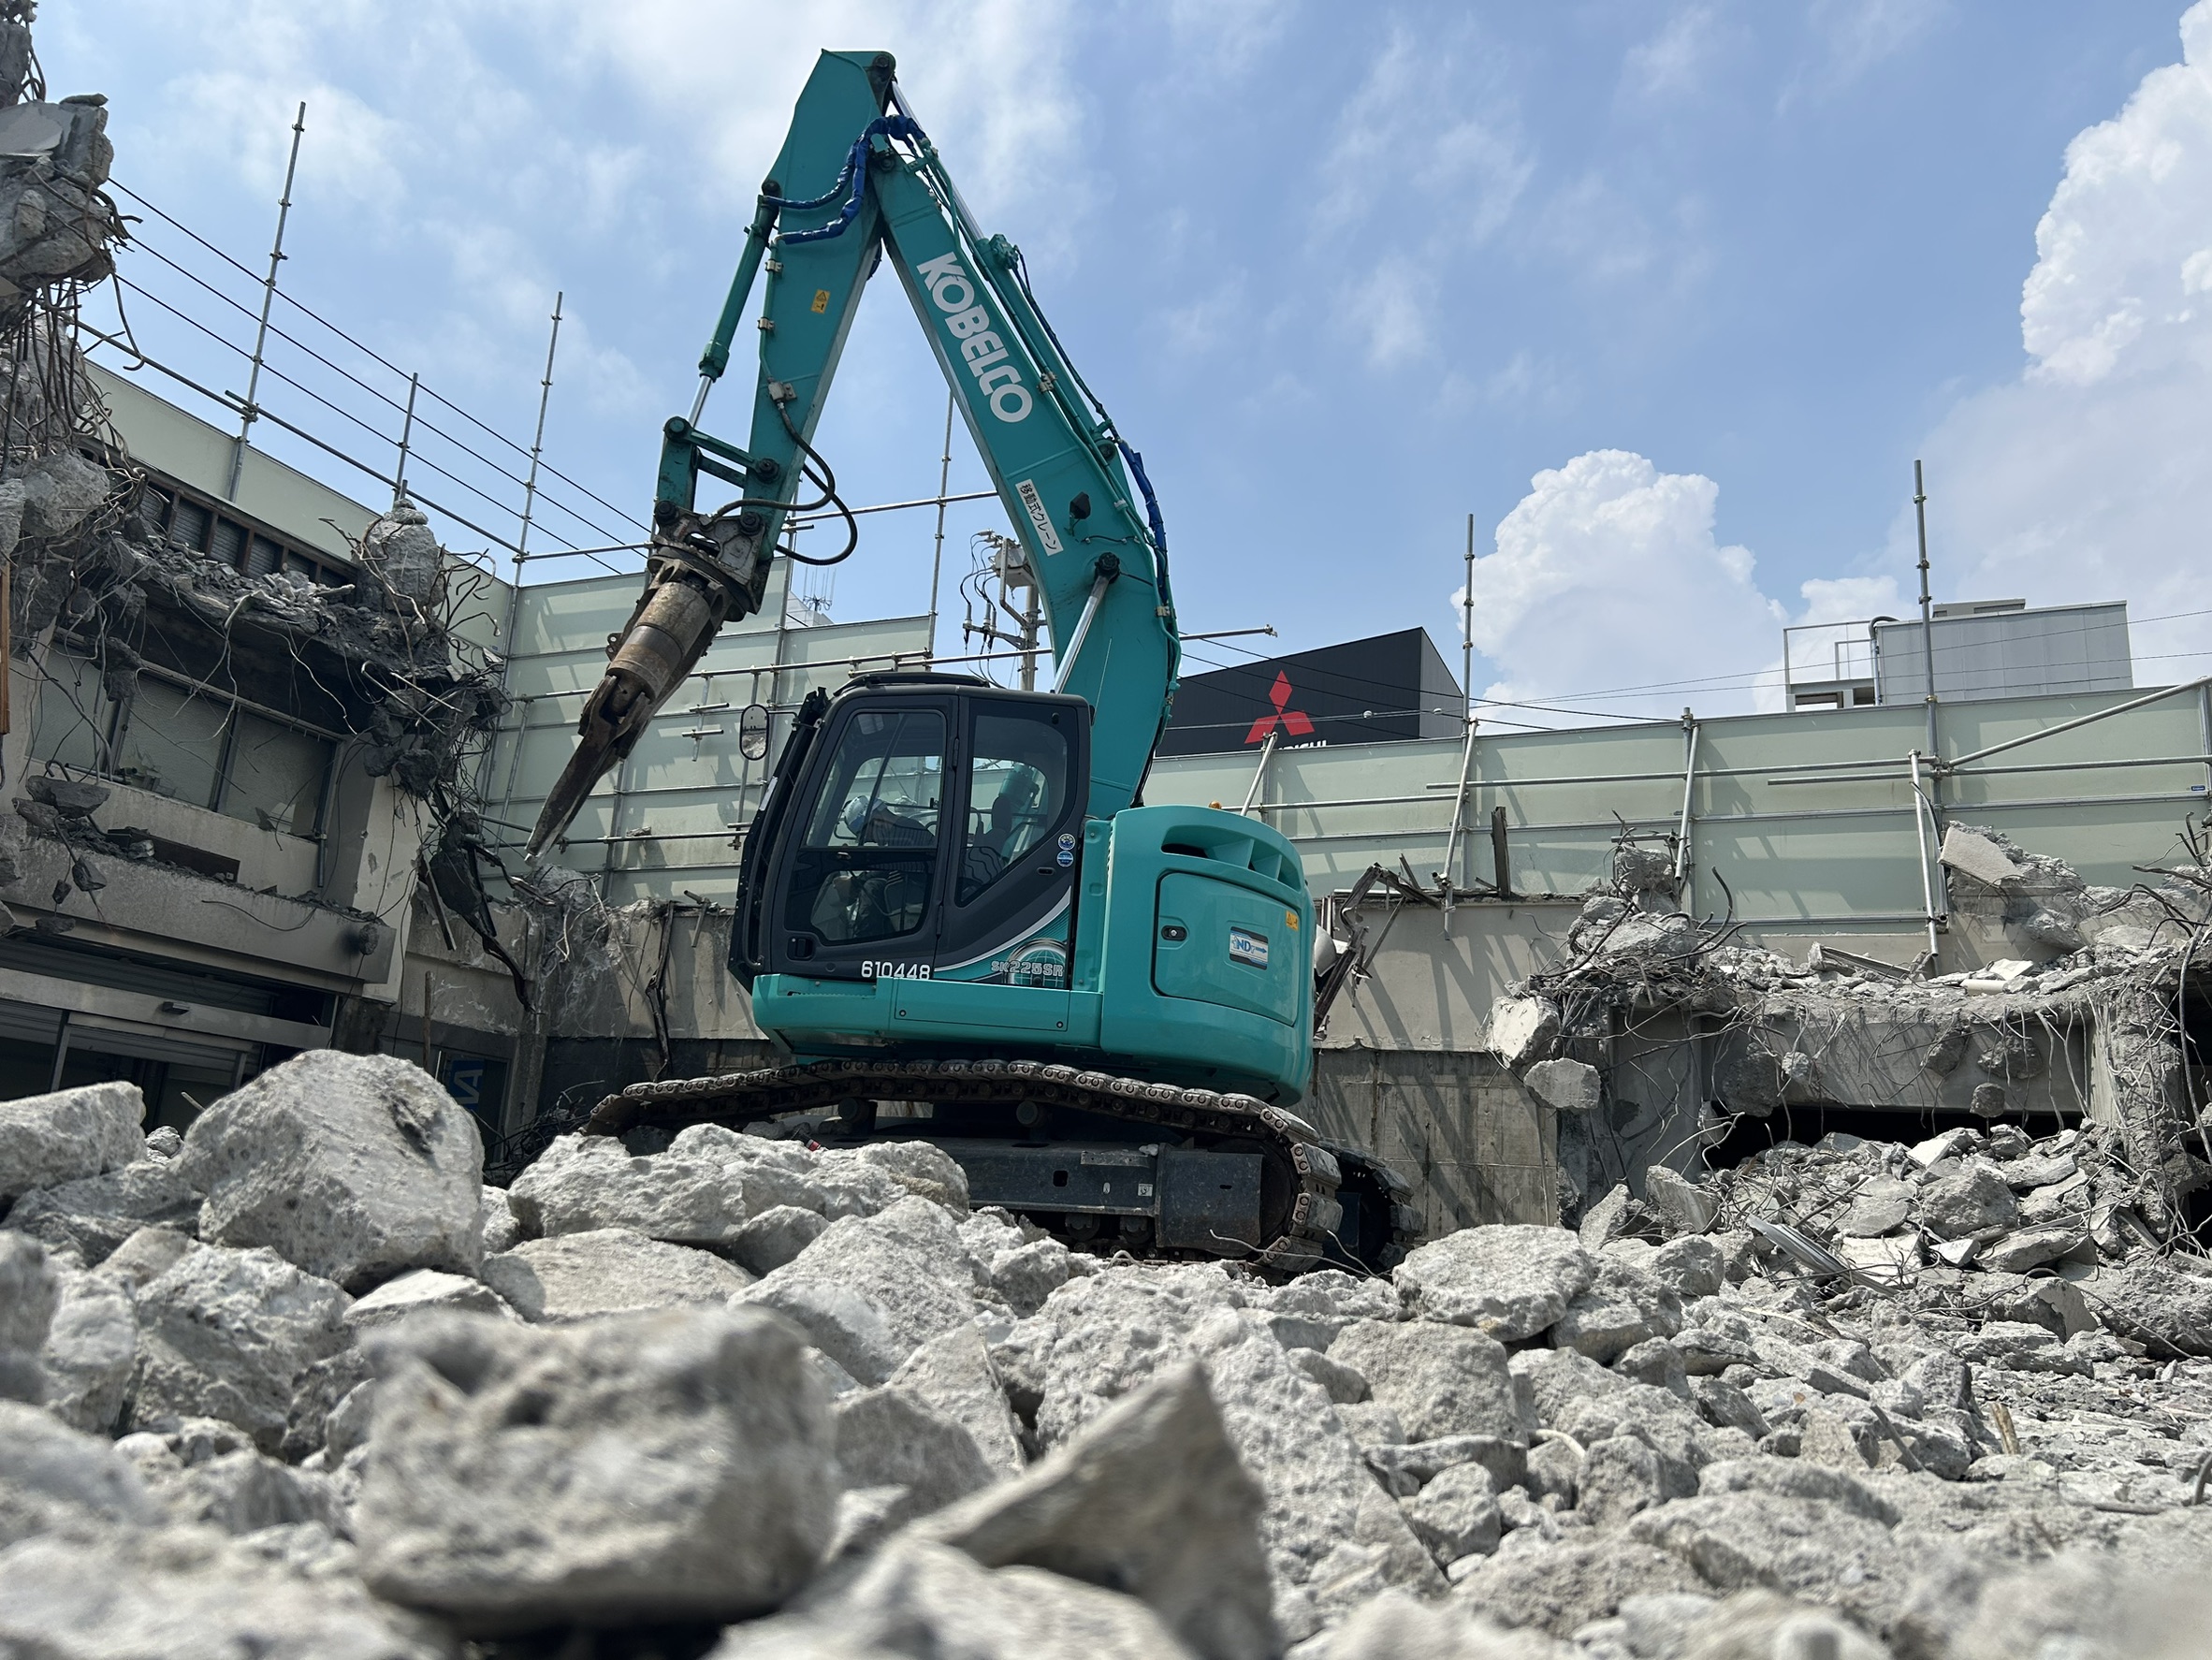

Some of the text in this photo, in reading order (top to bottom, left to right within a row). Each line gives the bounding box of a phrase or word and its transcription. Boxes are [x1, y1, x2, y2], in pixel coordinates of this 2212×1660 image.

[916, 252, 1033, 423] KOBELCO
[1019, 483, 1057, 550] 移動式クレーン
[861, 960, 930, 980] 610448
[991, 959, 1065, 977] SK225SR
